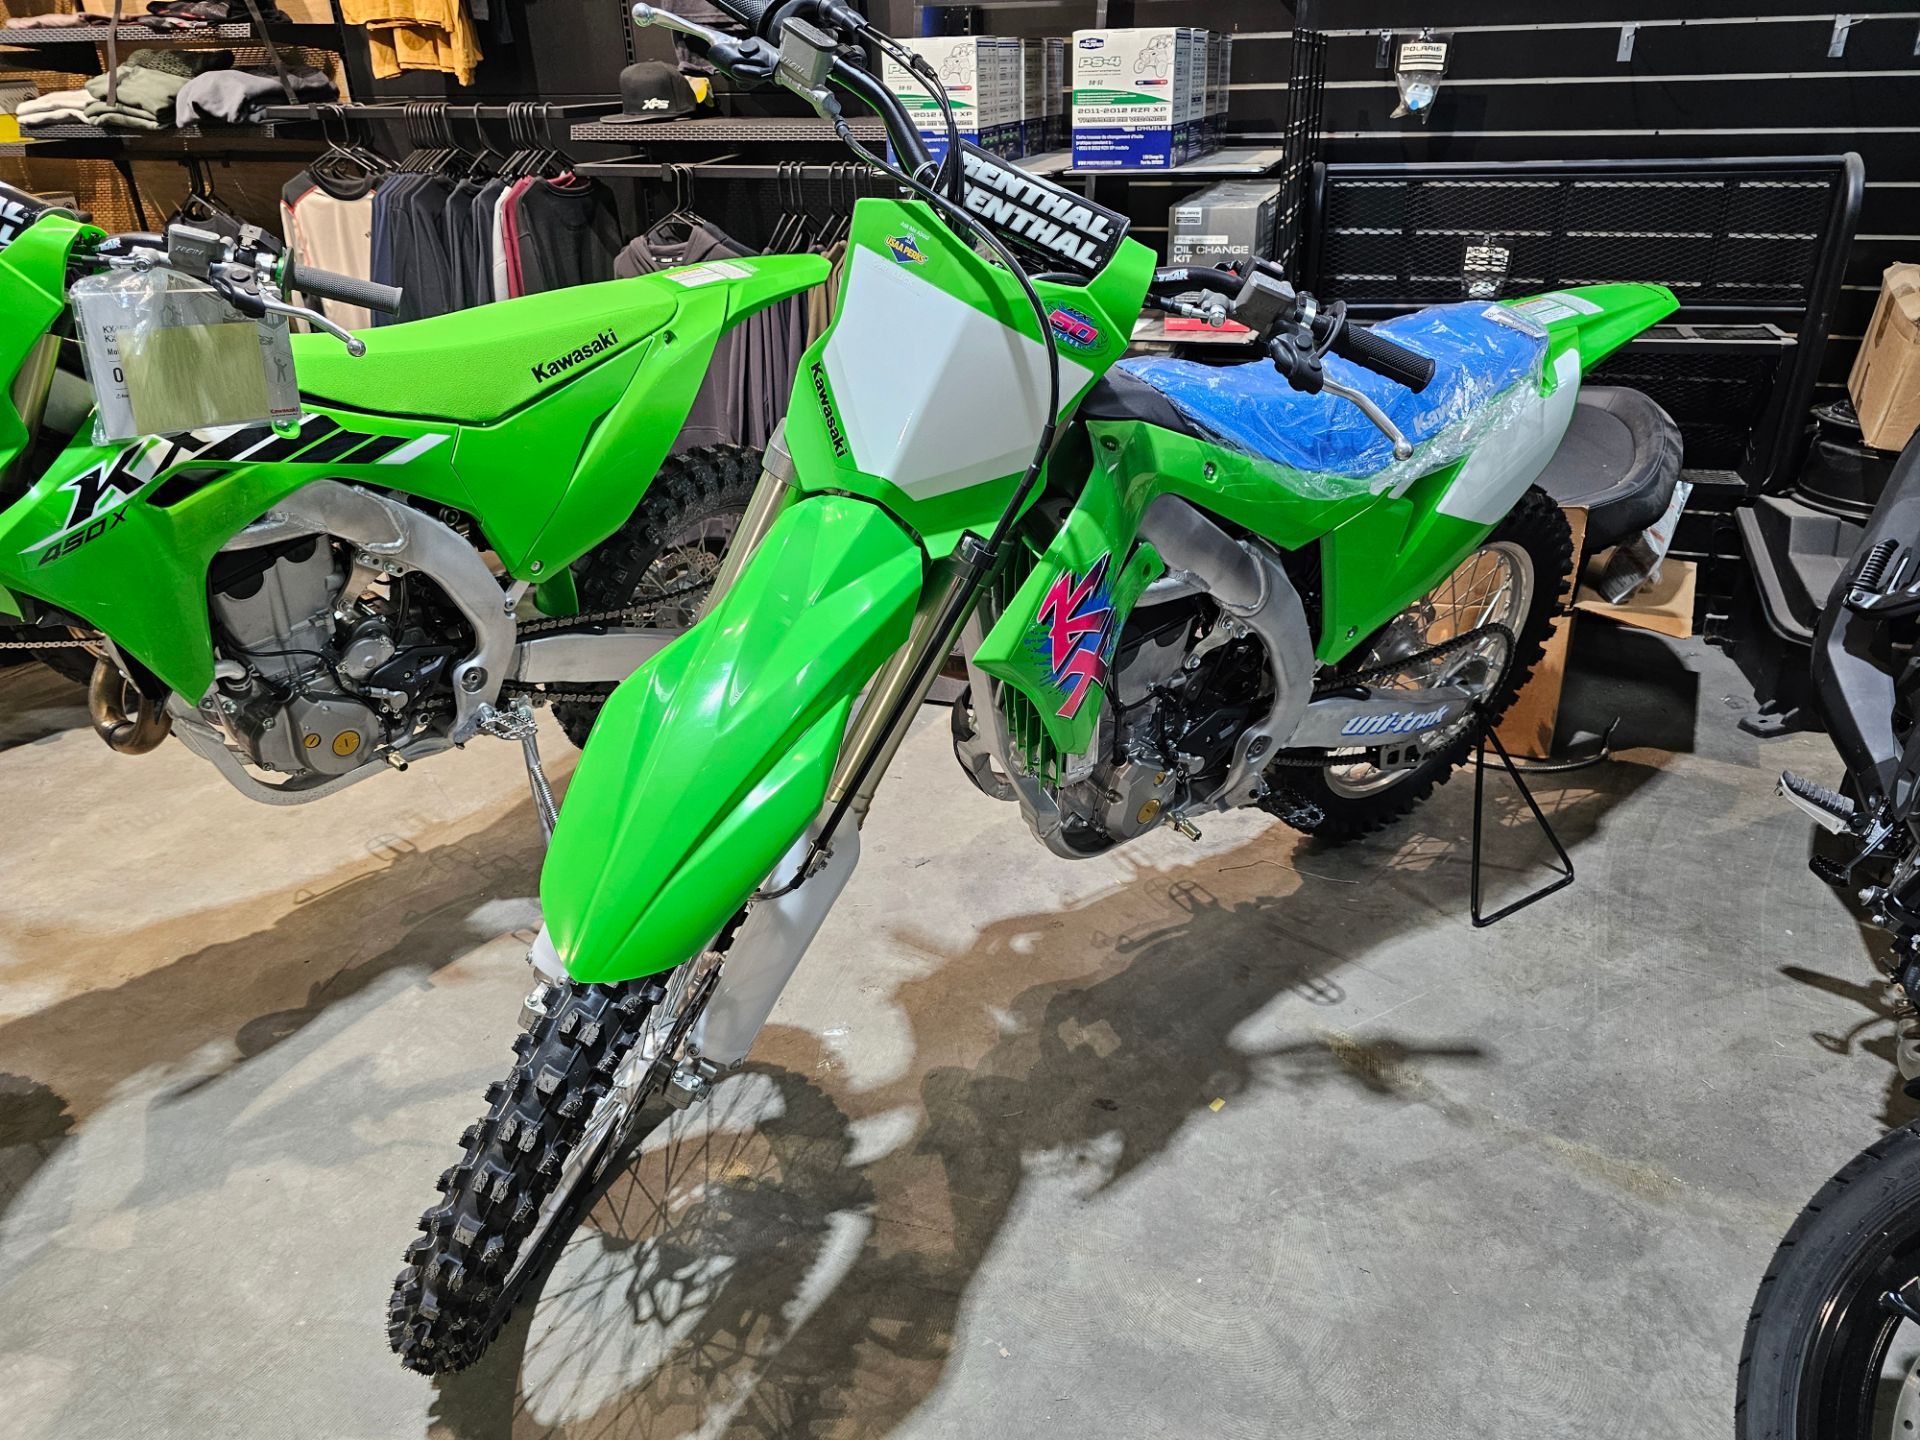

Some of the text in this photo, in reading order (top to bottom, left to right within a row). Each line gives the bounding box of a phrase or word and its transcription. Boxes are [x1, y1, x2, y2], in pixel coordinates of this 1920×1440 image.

[1078, 56, 1121, 68] PS-4
[642, 97, 670, 110] XPS
[1174, 245, 1249, 254] OIL CHANGE
[1174, 255, 1192, 263] KIT
[1048, 309, 1099, 345] 50
[531, 328, 619, 384] Kawasaki
[810, 361, 848, 458] Kawasaki
[1341, 704, 1450, 735] uni-trak
